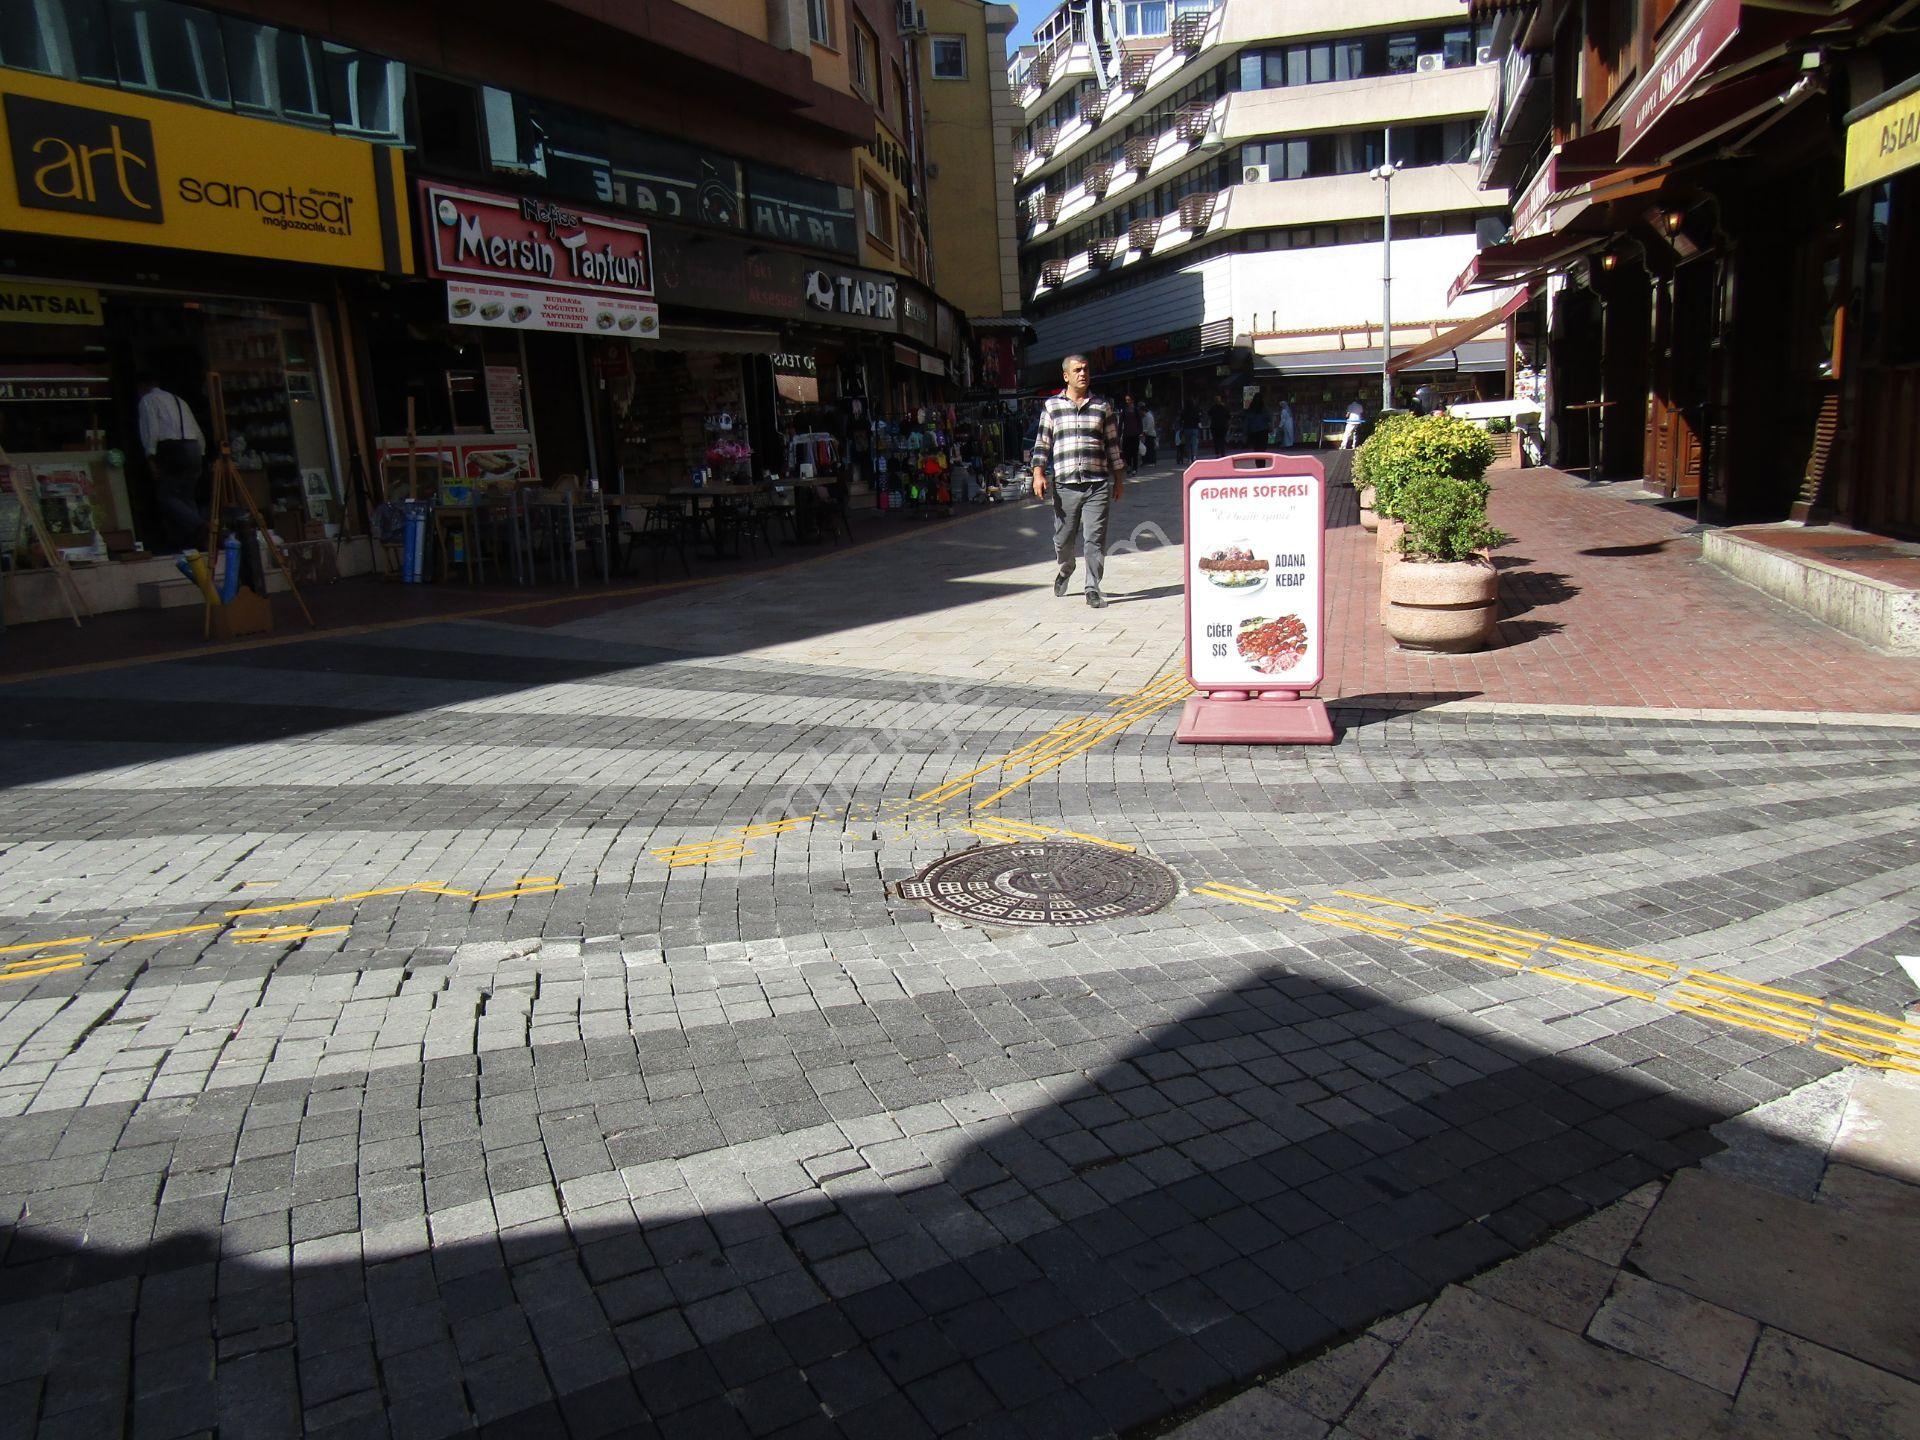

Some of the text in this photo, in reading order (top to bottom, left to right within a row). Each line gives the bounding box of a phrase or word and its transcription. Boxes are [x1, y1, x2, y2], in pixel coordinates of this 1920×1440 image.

[32, 124, 152, 210] art
[178, 177, 352, 236] sanatsal
[262, 215, 327, 234] mağazacılık
[520, 197, 579, 238] Nefiss
[456, 213, 555, 279] Mersin
[561, 230, 646, 288] Tantuni
[1200, 484, 1309, 500] ADANA SOFRASI
[1275, 554, 1306, 567] ADANA
[1275, 573, 1306, 587] KEBAP
[1206, 622, 1233, 638] CİĞER
